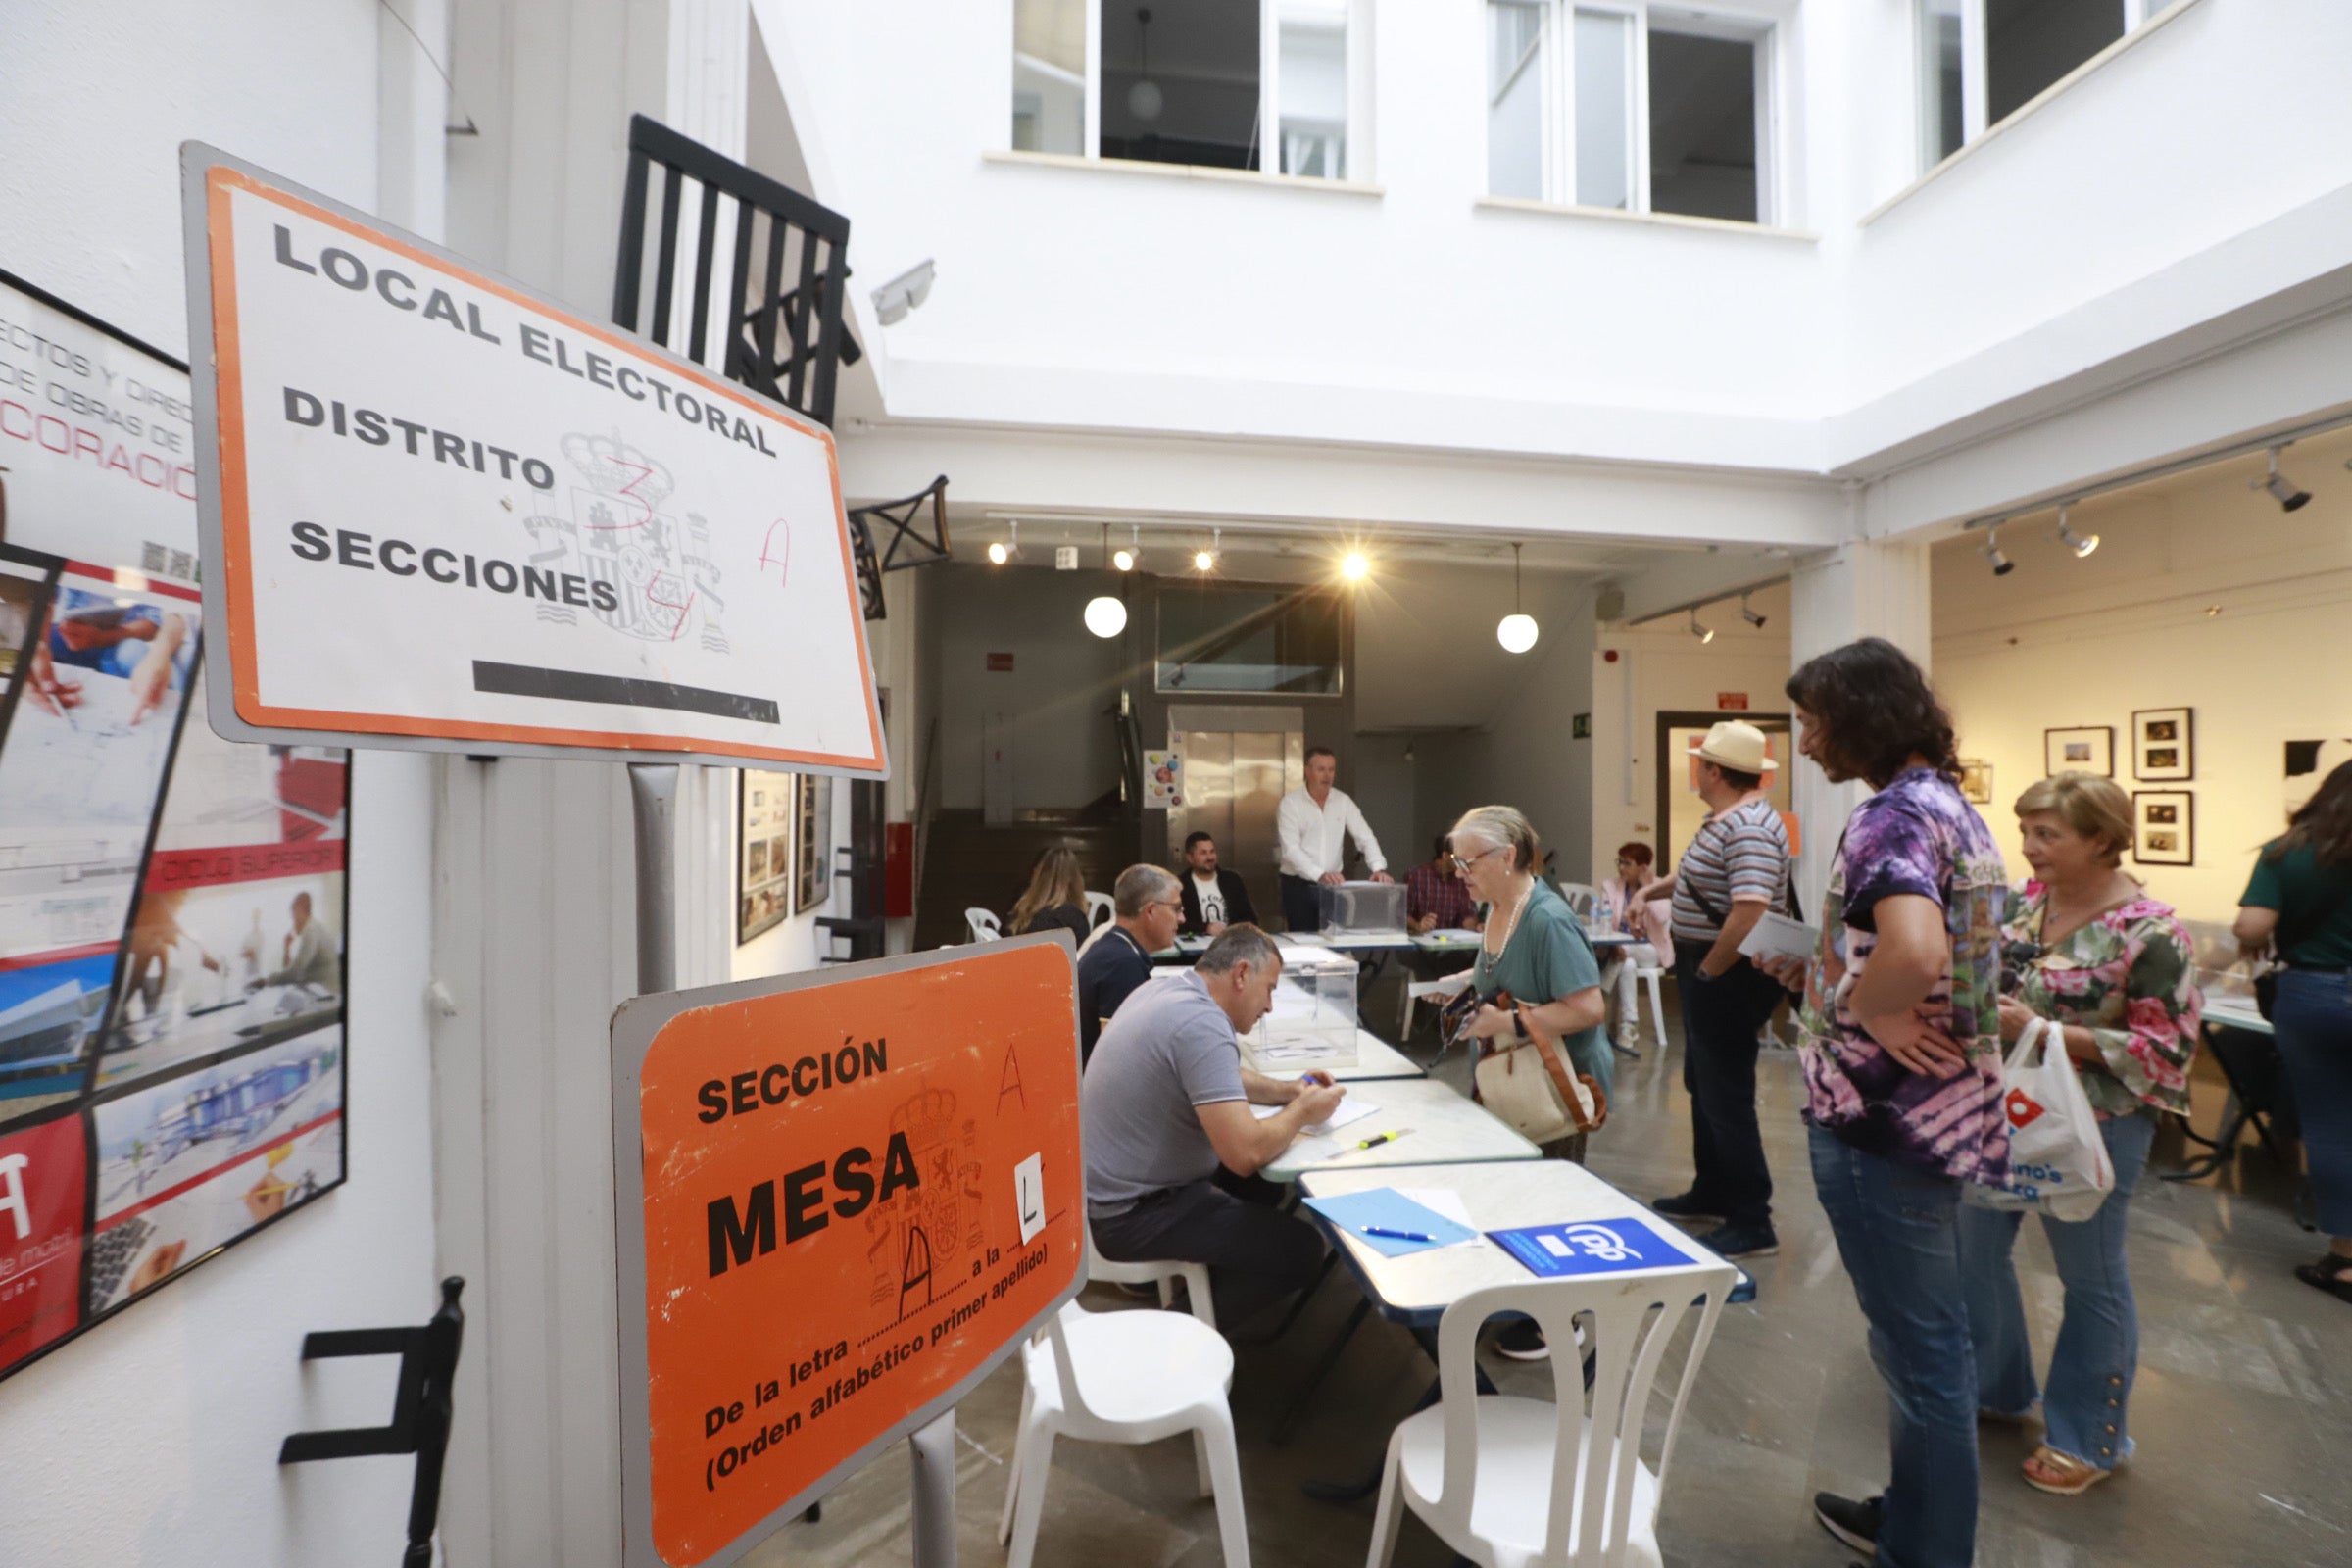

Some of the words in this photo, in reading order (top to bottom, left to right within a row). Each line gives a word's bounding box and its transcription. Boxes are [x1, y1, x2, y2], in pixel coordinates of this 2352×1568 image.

[99, 365, 118, 386] Y
[274, 224, 502, 346] LOCAL
[520, 323, 778, 459] ELECTORAL
[45, 380, 143, 438] OBRAS
[150, 423, 183, 455] DE
[283, 386, 556, 492] DISTRITO
[583, 456, 653, 530] 3
[290, 520, 618, 612] SECCIONES
[759, 518, 791, 588] A
[698, 1036, 888, 1124] SECCIÓN
[996, 1042, 1027, 1117] A
[707, 1131, 921, 1280] MESA
[1023, 1175, 1037, 1225] L
[898, 1225, 932, 1324] A
[705, 1401, 745, 1440] De
[755, 1380, 780, 1409] la
[789, 1339, 848, 1389] letra
[972, 1258, 982, 1278] a
[986, 1246, 1001, 1268] la
[706, 1412, 802, 1493] (Orden
[809, 1333, 925, 1421] alfabético
[931, 1291, 988, 1347] primer
[992, 1242, 1049, 1300] apellido)
